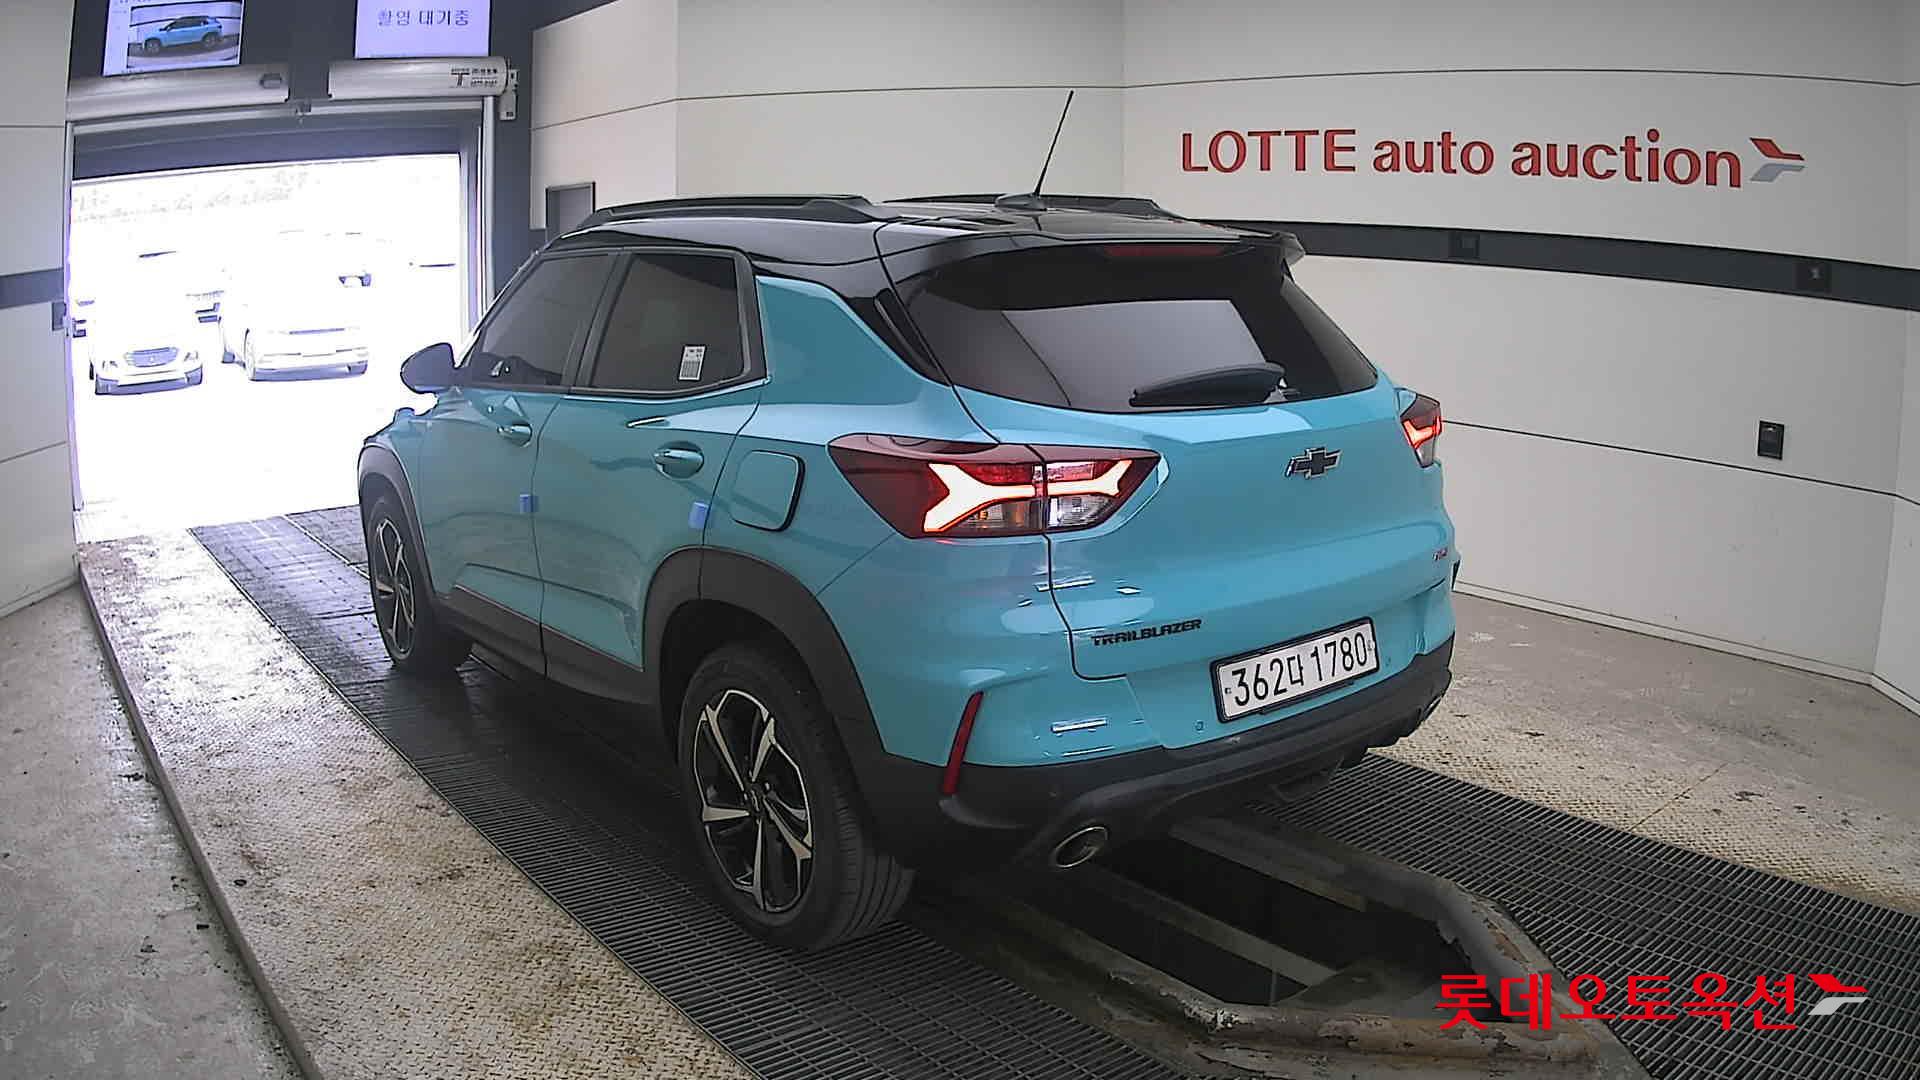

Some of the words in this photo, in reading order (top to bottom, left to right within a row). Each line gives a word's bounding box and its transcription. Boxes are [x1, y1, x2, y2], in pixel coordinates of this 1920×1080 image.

[418, 9, 470, 26] 대기중
[1182, 129, 1356, 174] LOTTE
[1374, 130, 1495, 177] auto
[1512, 127, 1742, 188] auction
[1090, 618, 1202, 646] TRAILBLAZER
